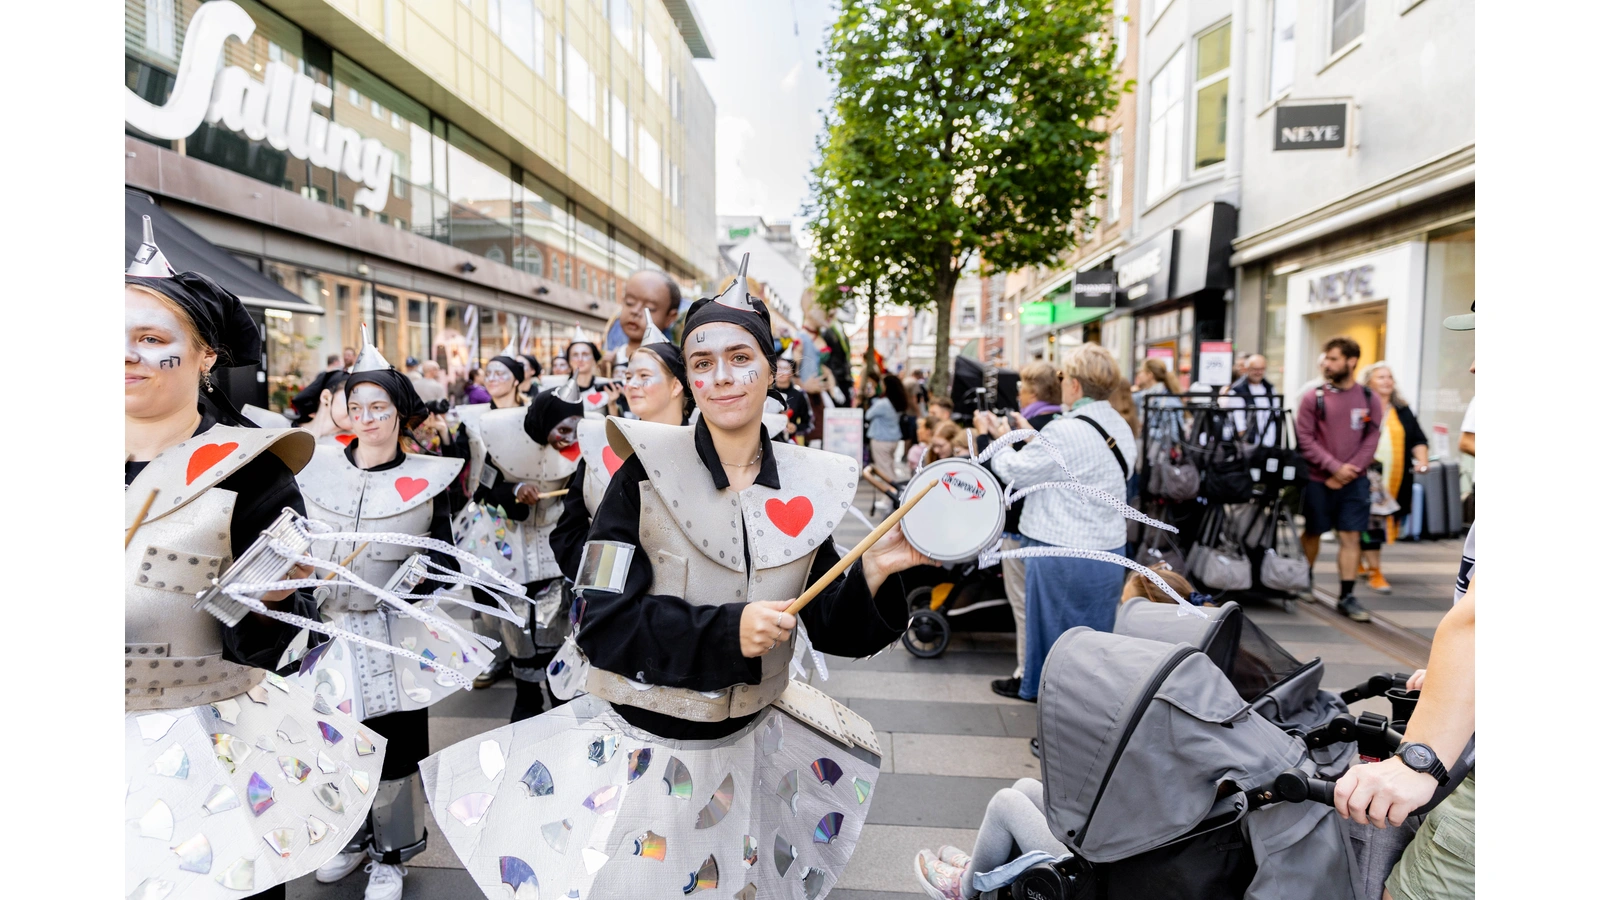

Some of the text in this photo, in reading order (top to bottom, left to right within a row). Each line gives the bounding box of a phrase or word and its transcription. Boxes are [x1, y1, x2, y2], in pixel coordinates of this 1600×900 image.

[123, 0, 394, 213] Salling
[1281, 124, 1340, 143] NEYE
[1308, 265, 1375, 304] NEYE
